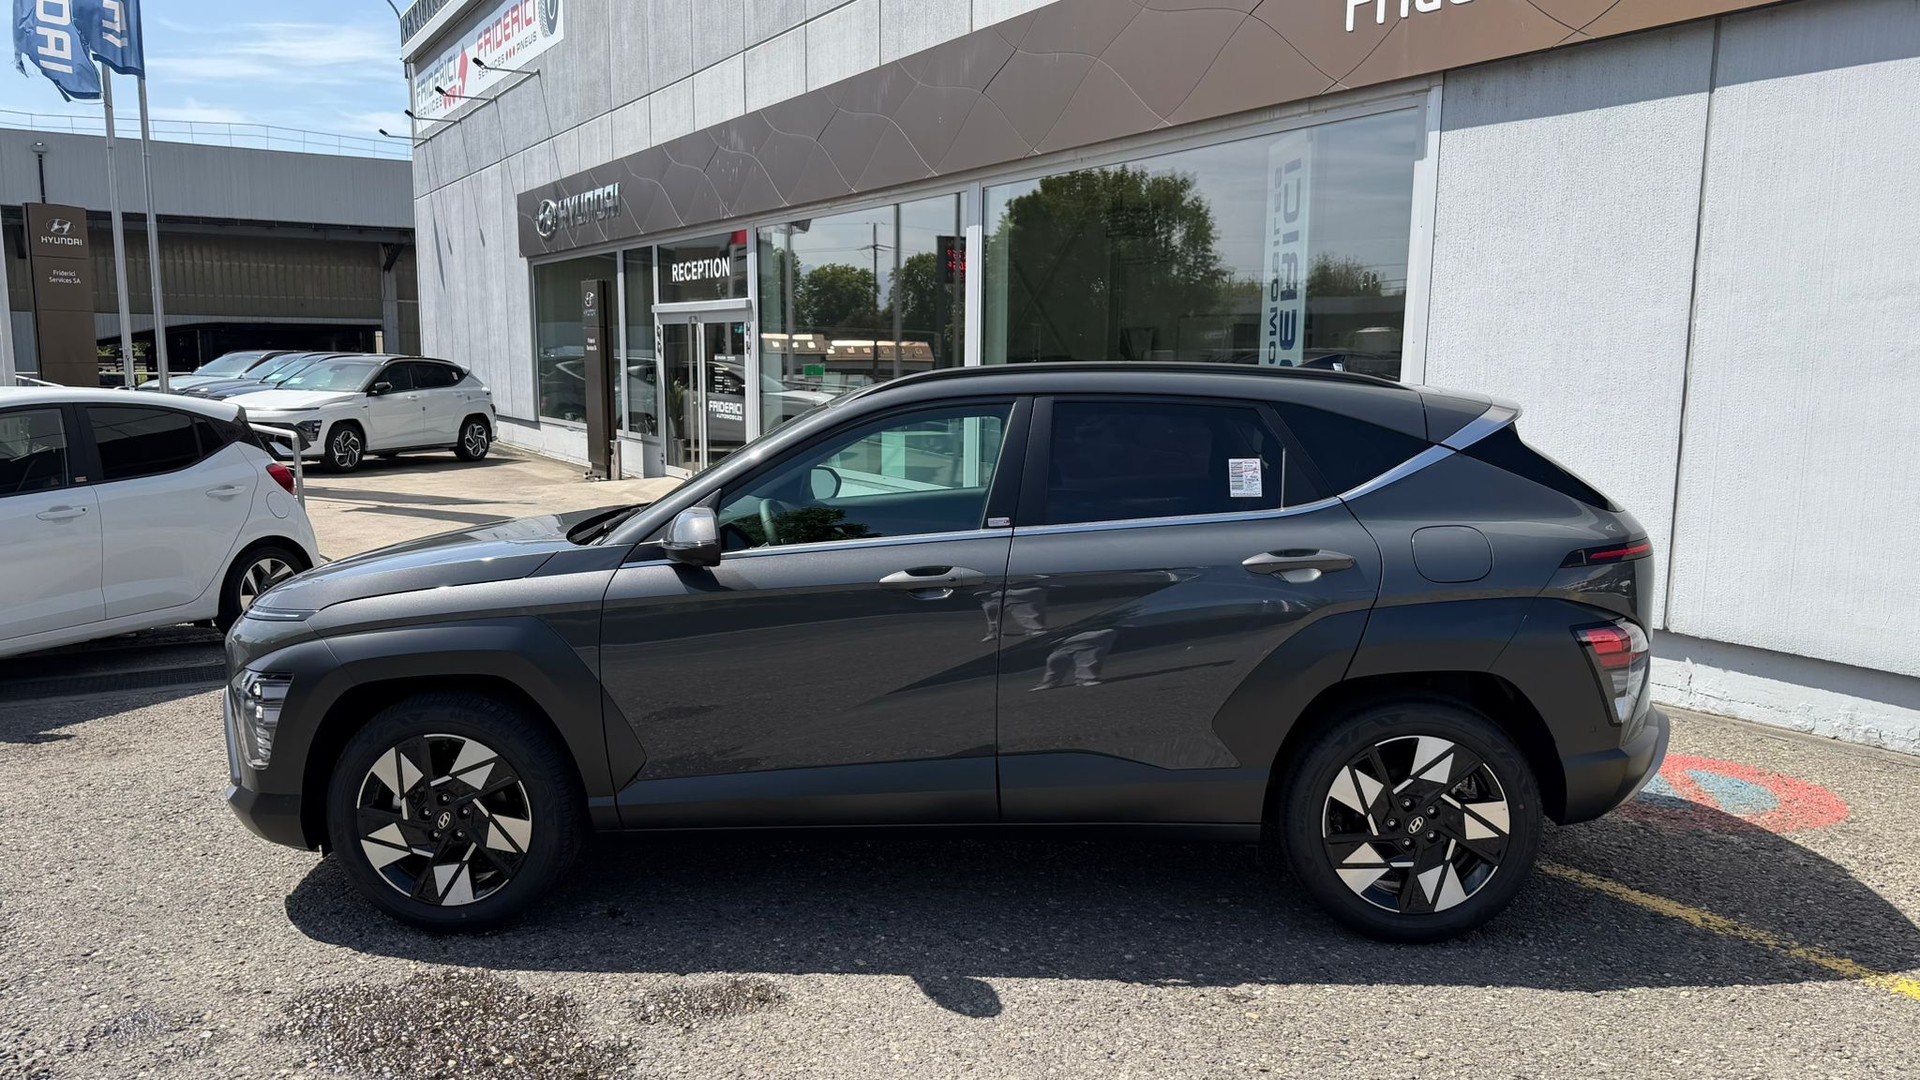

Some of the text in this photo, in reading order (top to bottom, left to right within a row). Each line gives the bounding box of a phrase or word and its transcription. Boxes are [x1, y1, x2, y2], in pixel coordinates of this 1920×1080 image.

[476, 0, 536, 59] FRIDERICI
[516, 31, 537, 53] PNEUS
[416, 53, 457, 108] FRIDERICI
[558, 182, 621, 230] HYUNDAI
[40, 235, 83, 246] HYUNDAI
[52, 269, 76, 277] Friderici
[671, 256, 730, 282] RECEPTION
[708, 400, 743, 415] FRIDERICI
